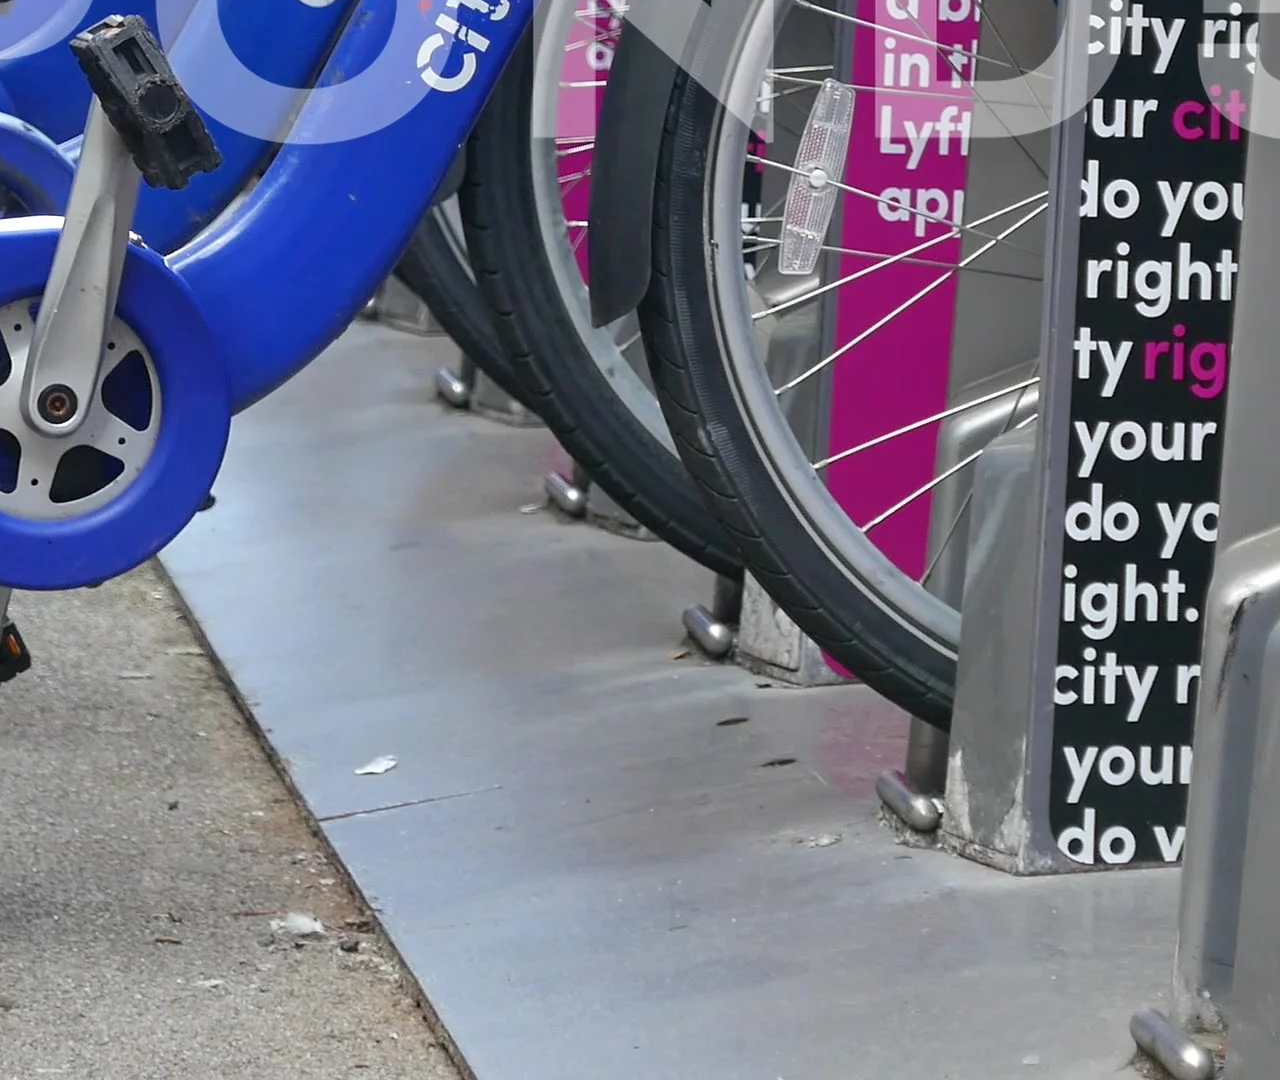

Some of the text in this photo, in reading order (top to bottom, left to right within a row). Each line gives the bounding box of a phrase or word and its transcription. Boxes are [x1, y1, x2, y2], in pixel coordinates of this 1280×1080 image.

[883, 37, 930, 88] in
[879, 104, 972, 170] Lyft
[1083, 83, 1247, 141] ur cit
[1079, 159, 1141, 219] do
[1086, 241, 1239, 318] right
[1073, 324, 1227, 399] ty rig
[1073, 420, 1218, 478] your
[1064, 483, 1140, 543] do
[1062, 563, 1200, 641] ight.
[1053, 647, 1201, 722] city r
[1057, 807, 1137, 865] do
